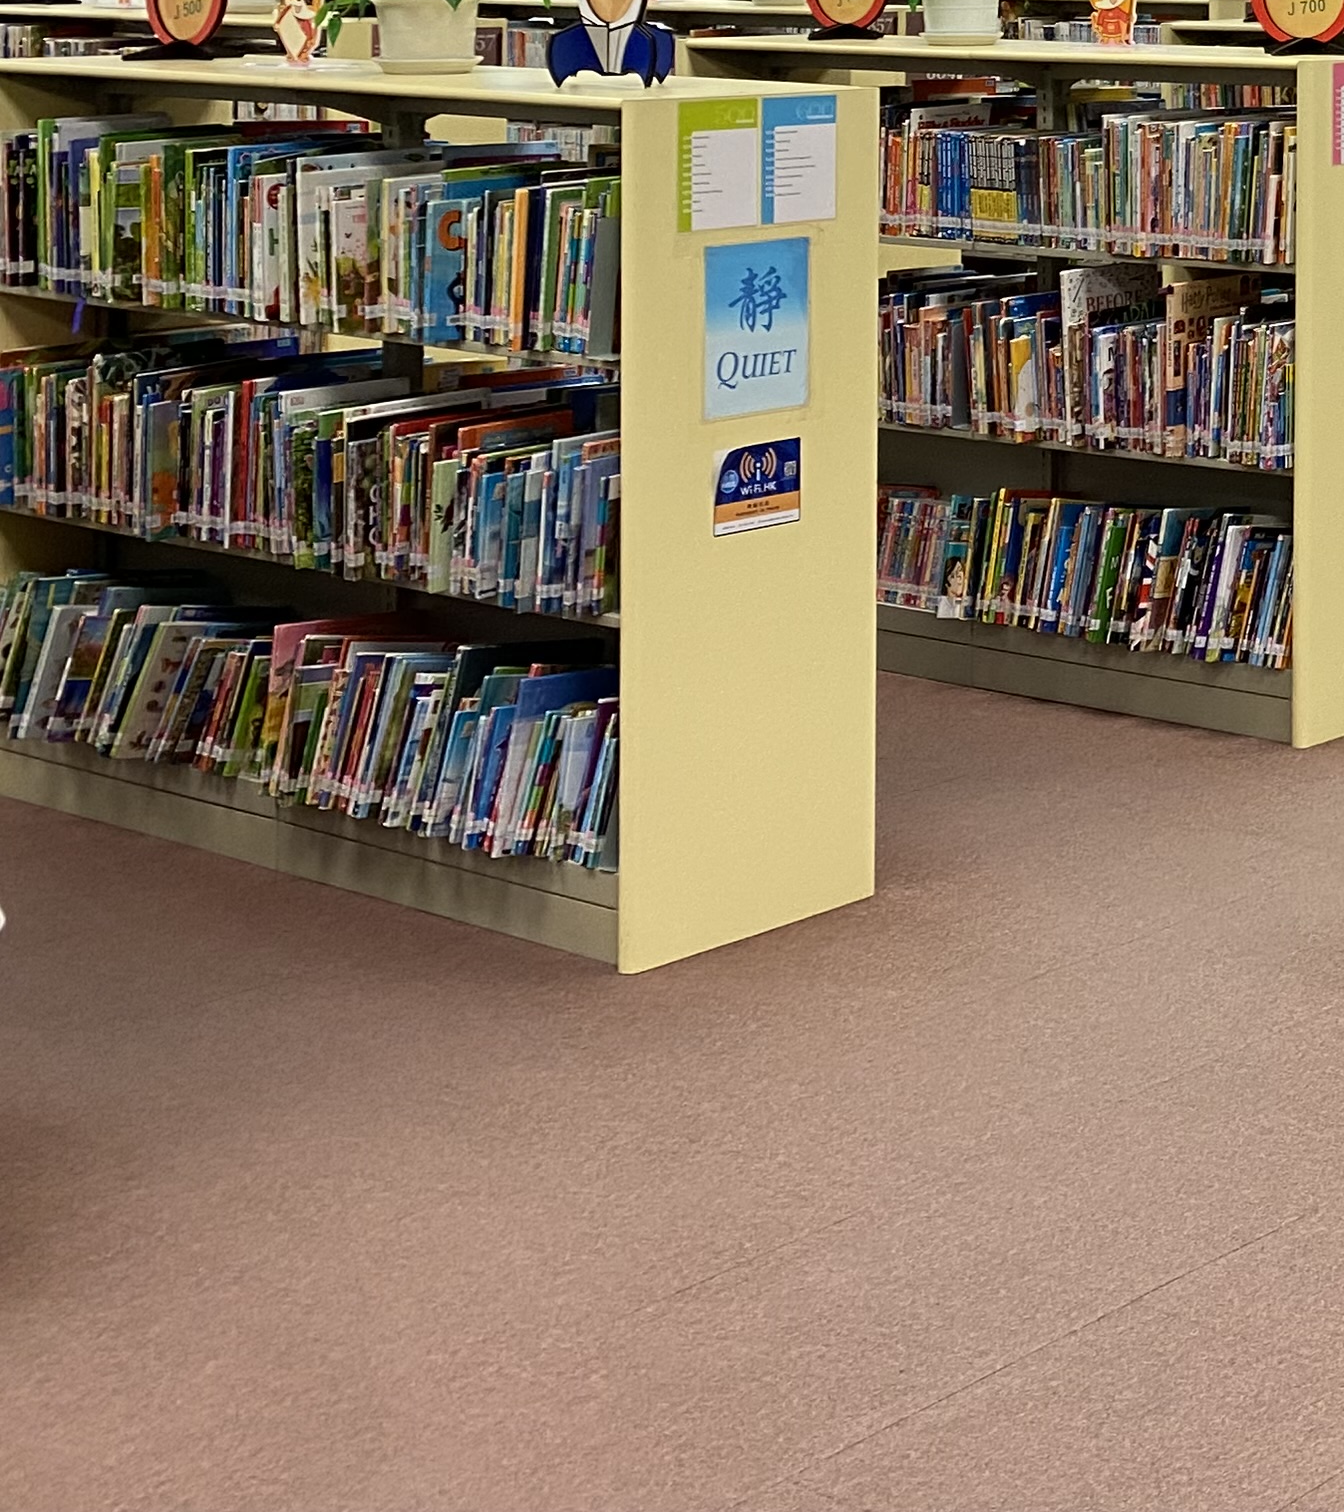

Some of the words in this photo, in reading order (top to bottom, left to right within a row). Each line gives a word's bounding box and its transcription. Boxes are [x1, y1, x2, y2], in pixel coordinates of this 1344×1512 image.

[174, 5, 180, 20] J
[183, 0, 202, 18] 500
[1287, 2, 1296, 16] J
[1300, 0, 1326, 15] 700
[729, 266, 787, 333] 靜
[716, 349, 797, 389] QUIET
